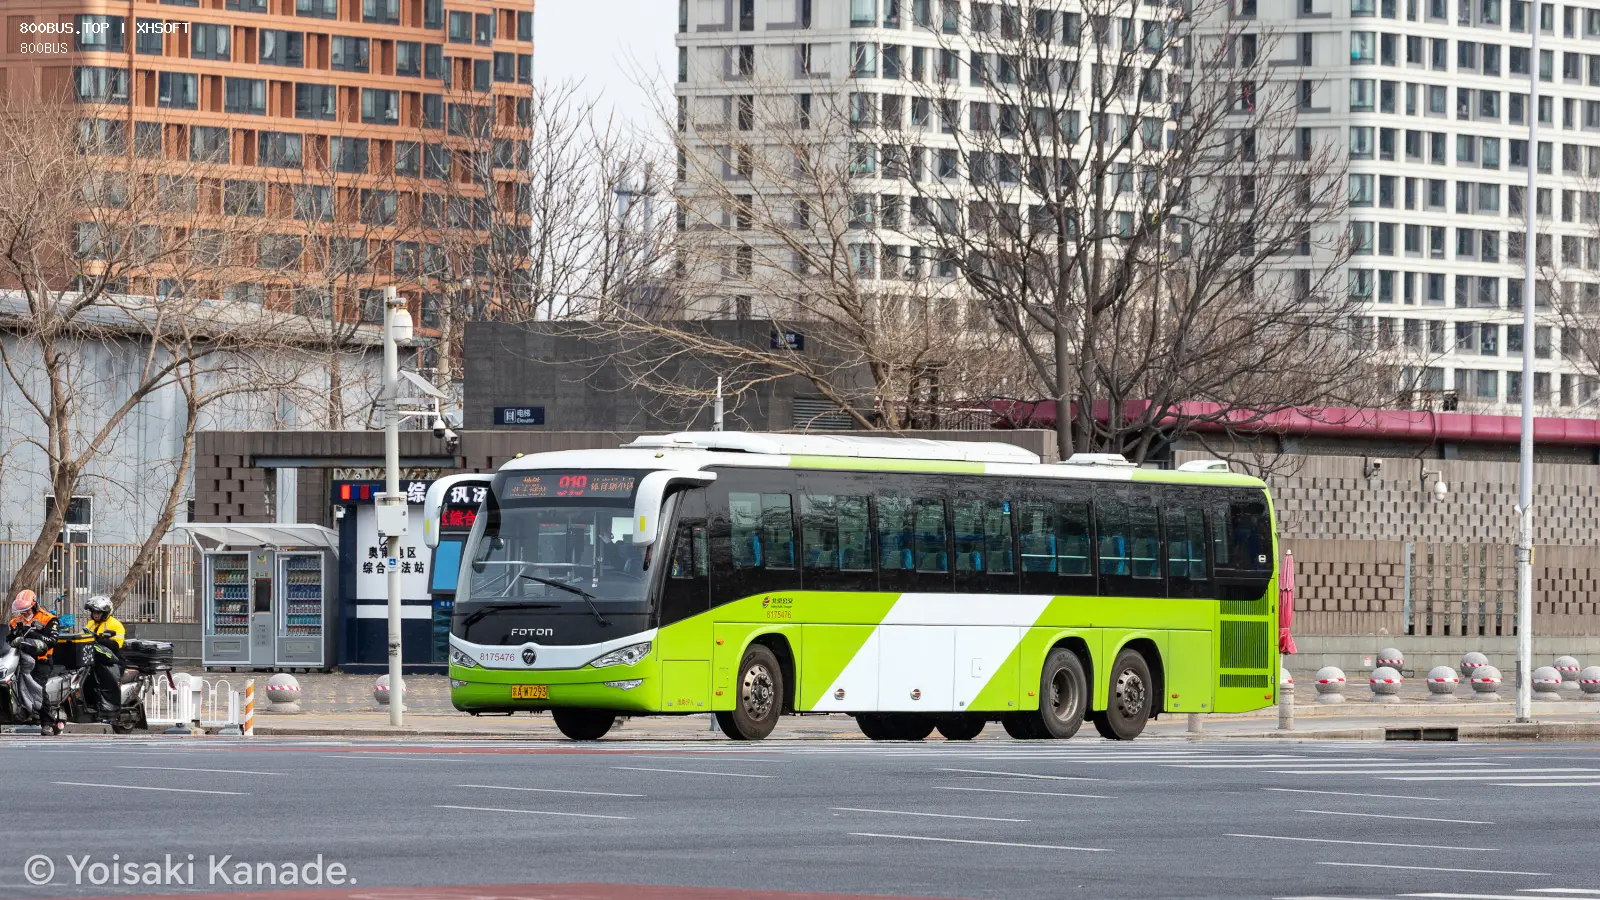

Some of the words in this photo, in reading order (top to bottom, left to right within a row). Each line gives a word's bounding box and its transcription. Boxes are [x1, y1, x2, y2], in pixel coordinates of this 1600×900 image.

[516, 409, 531, 418] 电梯
[362, 561, 425, 575] 综合法站
[766, 610, 791, 619] 8175476
[511, 628, 554, 637] FOTON
[479, 652, 516, 662] 8175476
